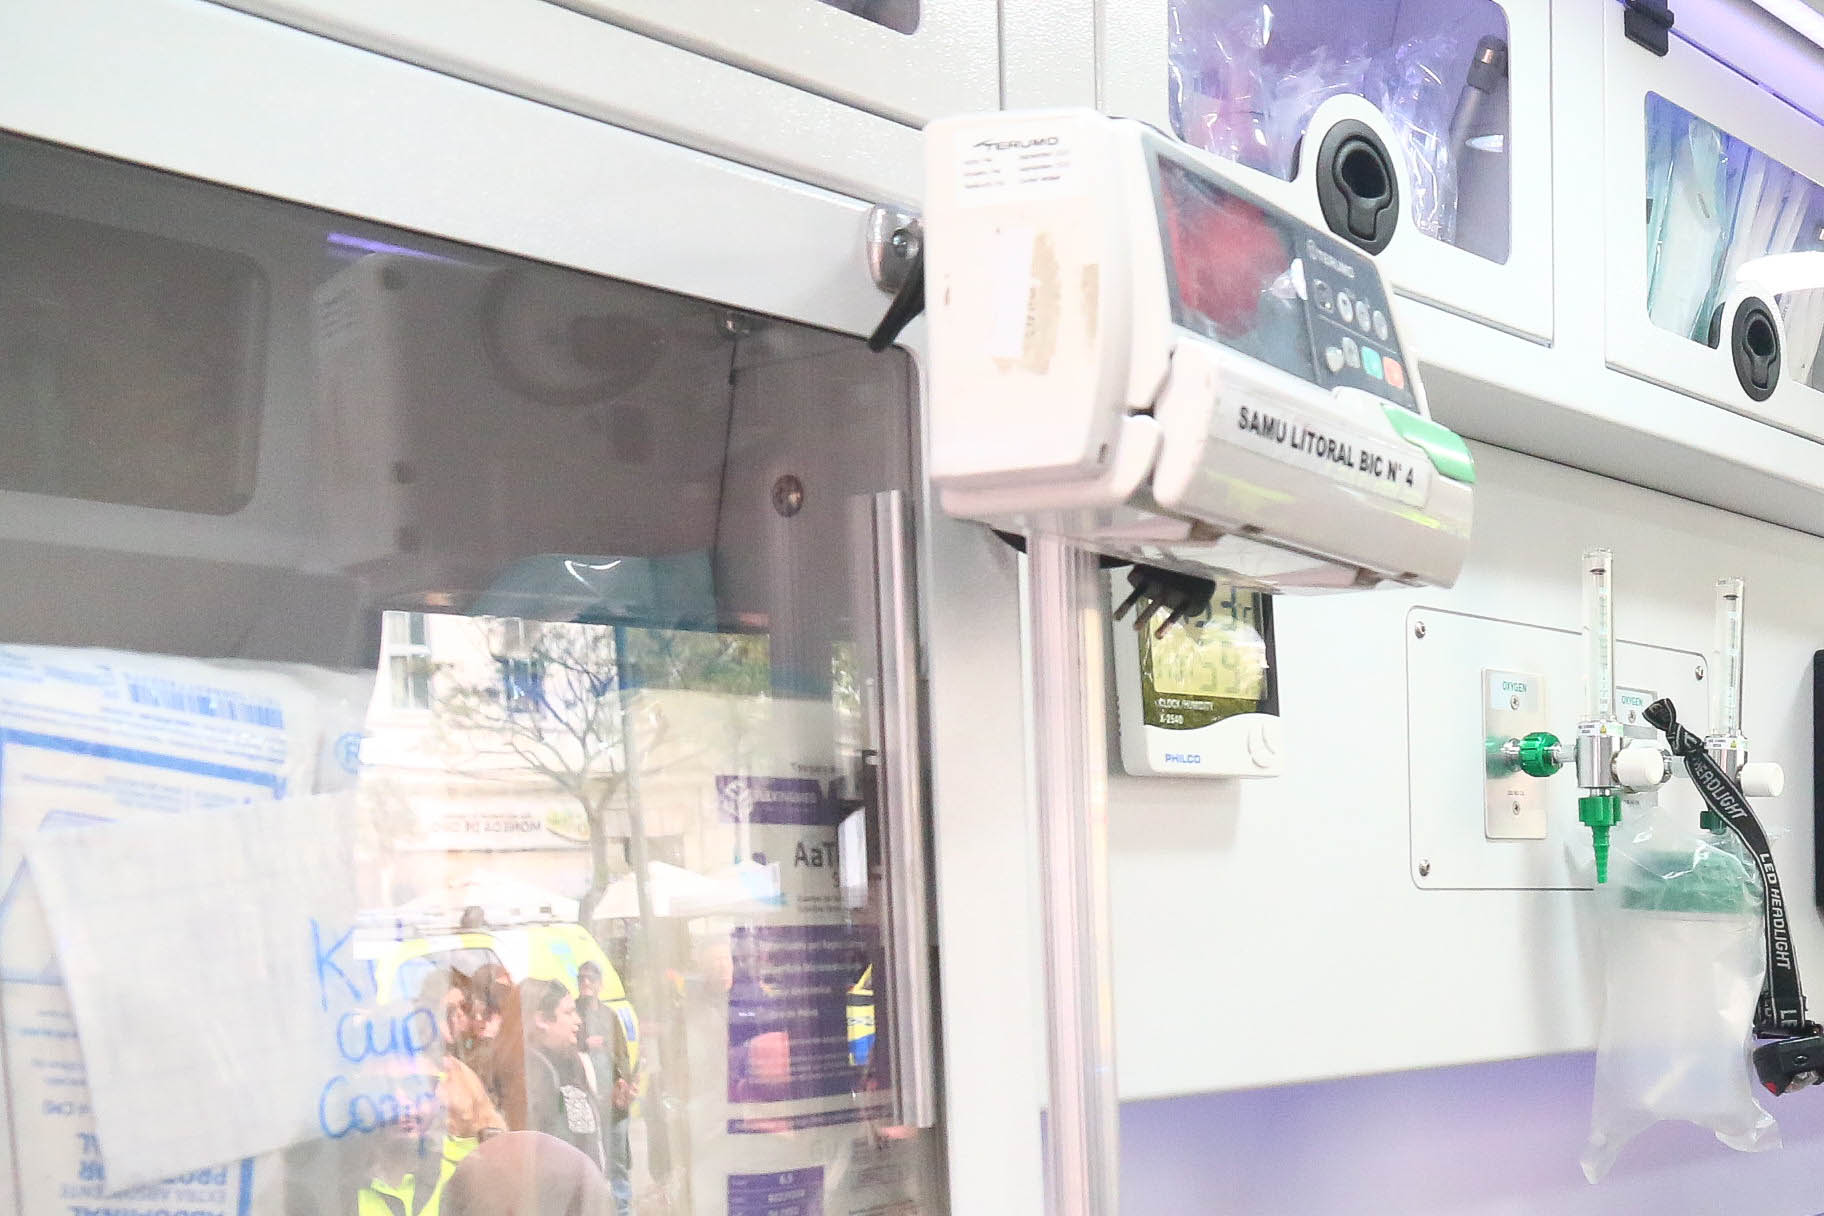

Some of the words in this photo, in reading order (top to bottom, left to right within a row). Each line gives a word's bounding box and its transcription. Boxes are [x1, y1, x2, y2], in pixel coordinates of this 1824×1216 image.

[1238, 406, 1288, 445] SAMU
[1289, 424, 1356, 467] LITORAL
[1358, 446, 1384, 474] BIC
[1405, 470, 1415, 486] 4
[1502, 679, 1528, 694] OXYGEN
[1621, 696, 1643, 708] OXYGEN
[1165, 753, 1201, 763] PHILCO
[1759, 852, 1777, 886] LED
[1770, 886, 1792, 970] HEADLIGHT
